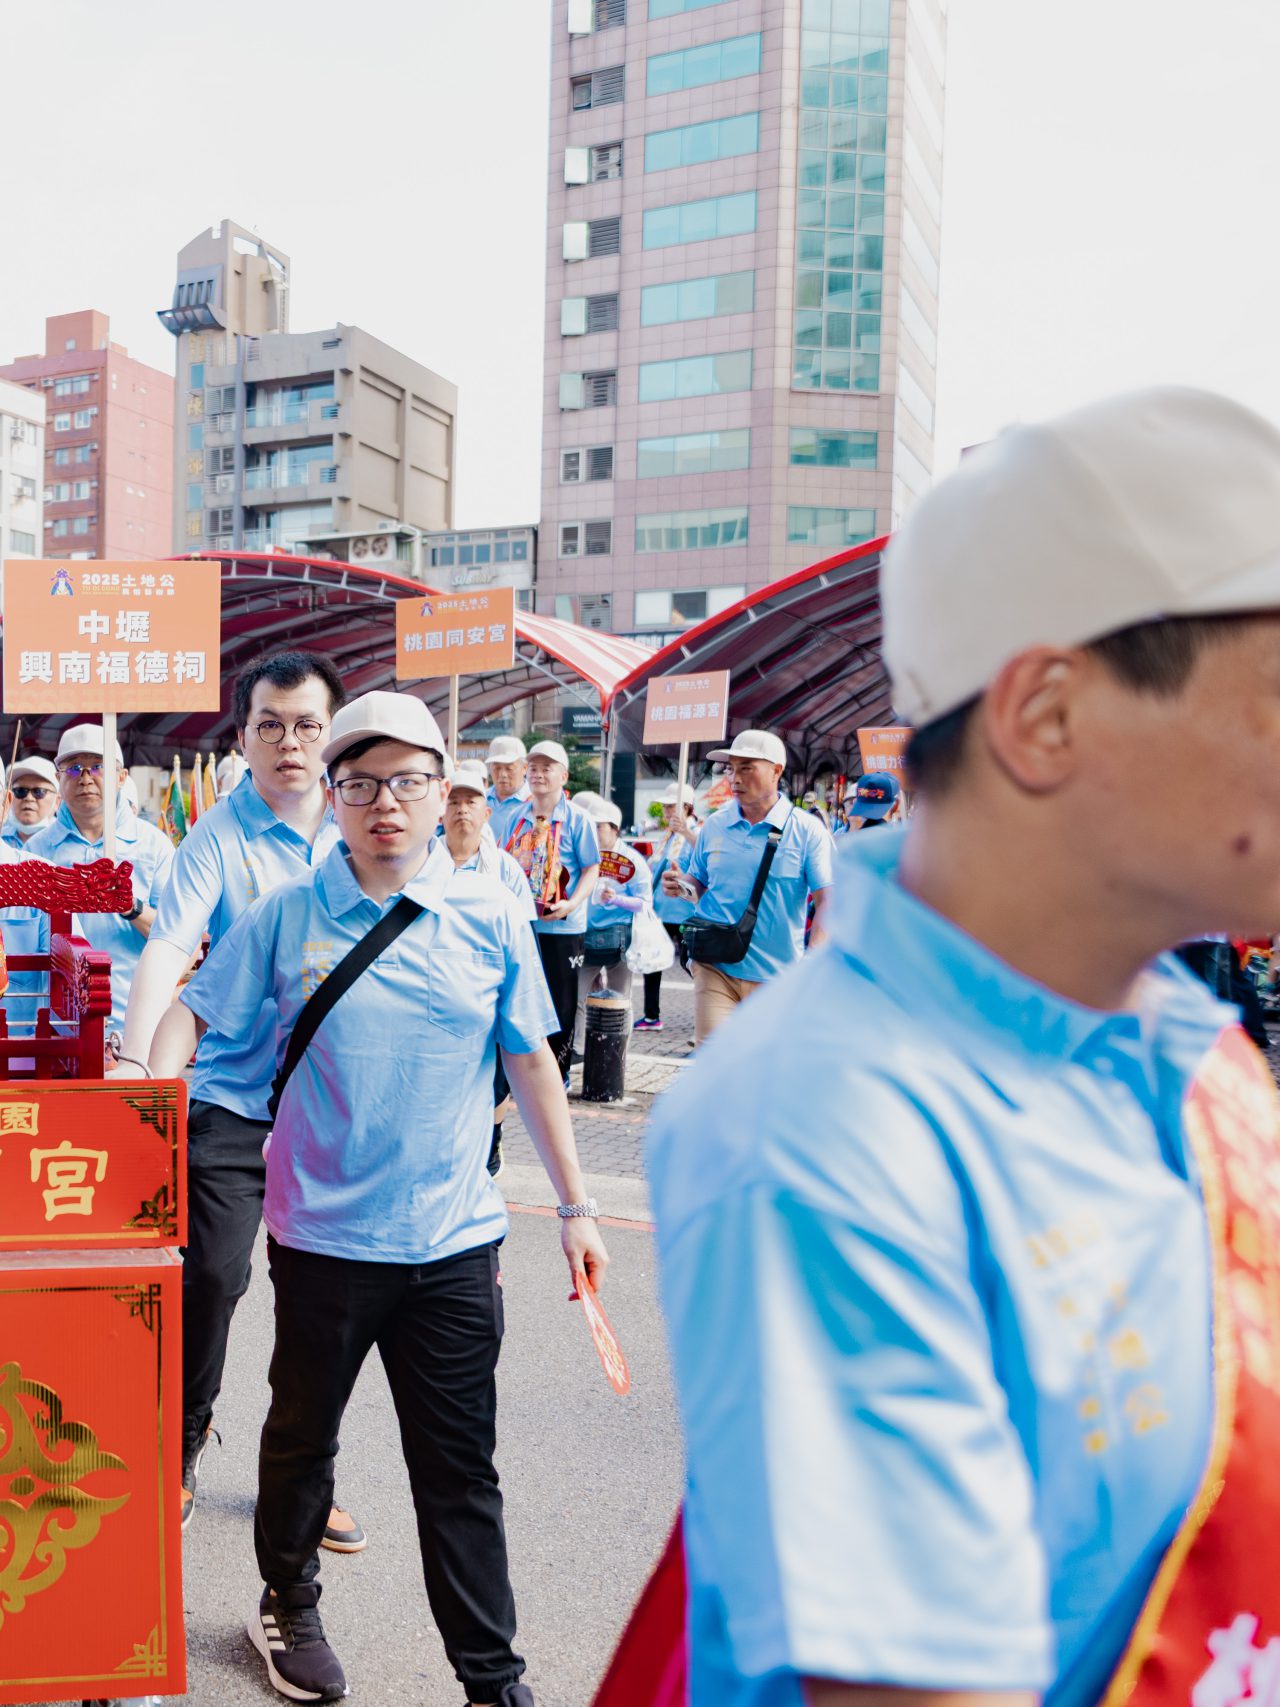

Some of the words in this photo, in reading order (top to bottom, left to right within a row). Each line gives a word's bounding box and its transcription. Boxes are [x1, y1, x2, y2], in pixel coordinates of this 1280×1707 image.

[82, 573, 175, 587] 2025土地公
[78, 609, 150, 644] 中壢
[403, 623, 507, 653] 桃園同安宮
[18, 650, 206, 685] 興南福德祠
